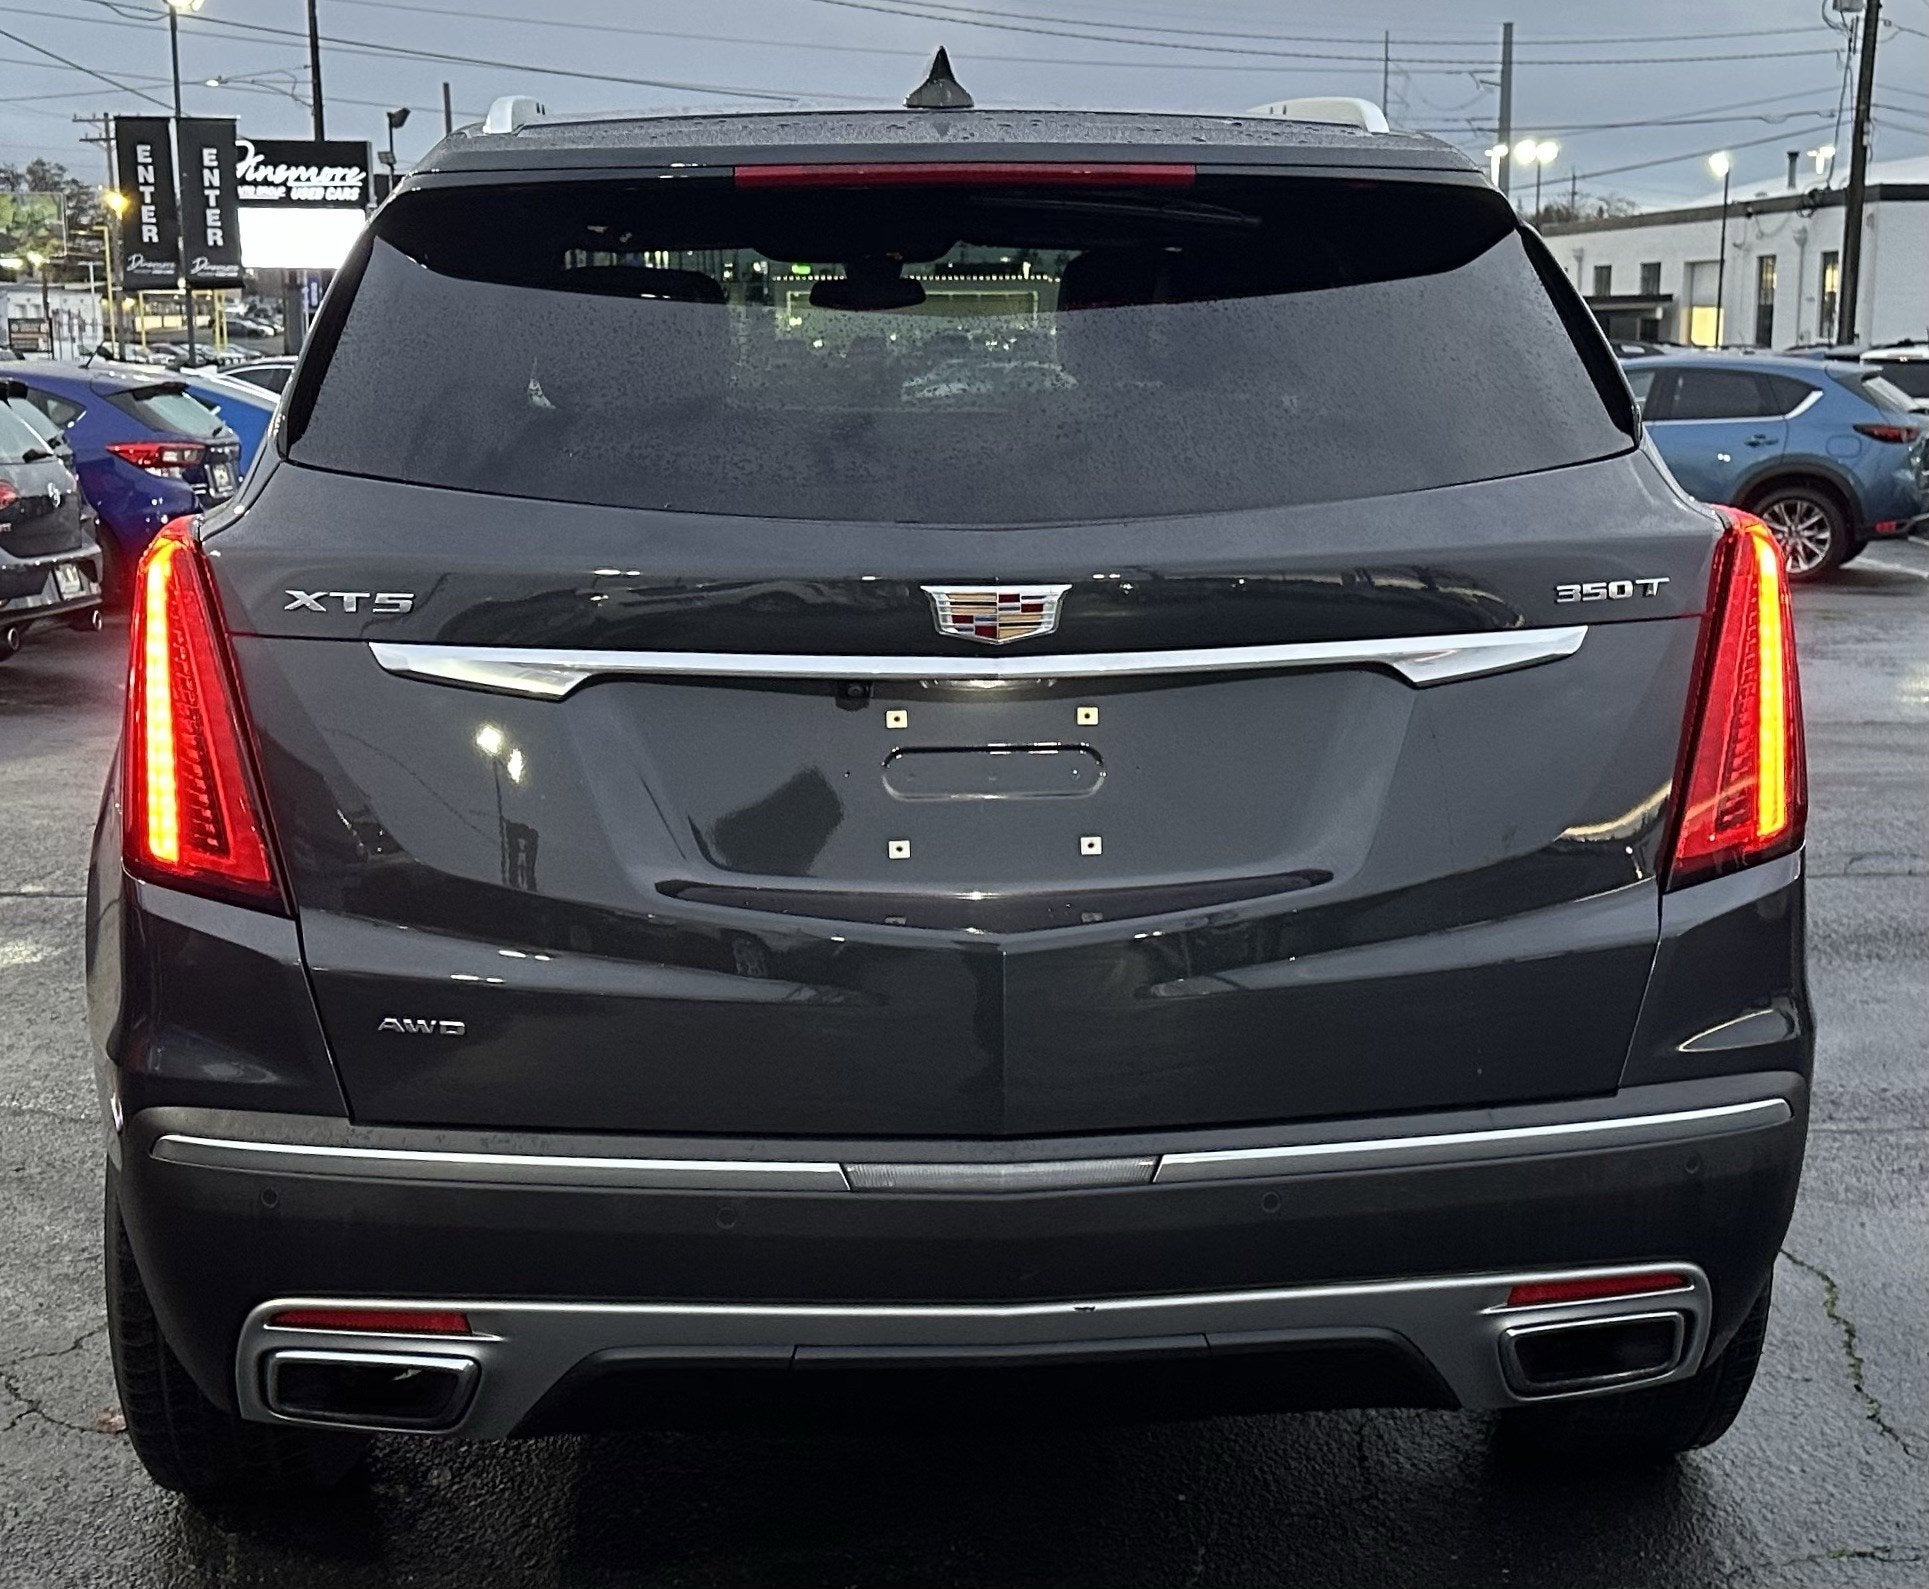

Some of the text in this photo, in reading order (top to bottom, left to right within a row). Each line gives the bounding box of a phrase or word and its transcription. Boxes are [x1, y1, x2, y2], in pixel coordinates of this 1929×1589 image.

[136, 144, 159, 243] ENTER
[202, 147, 224, 247] ENTER
[290, 186, 324, 200] USED
[325, 186, 361, 201] CARS
[284, 589, 415, 613] XT5
[377, 1017, 466, 1036] AWD
